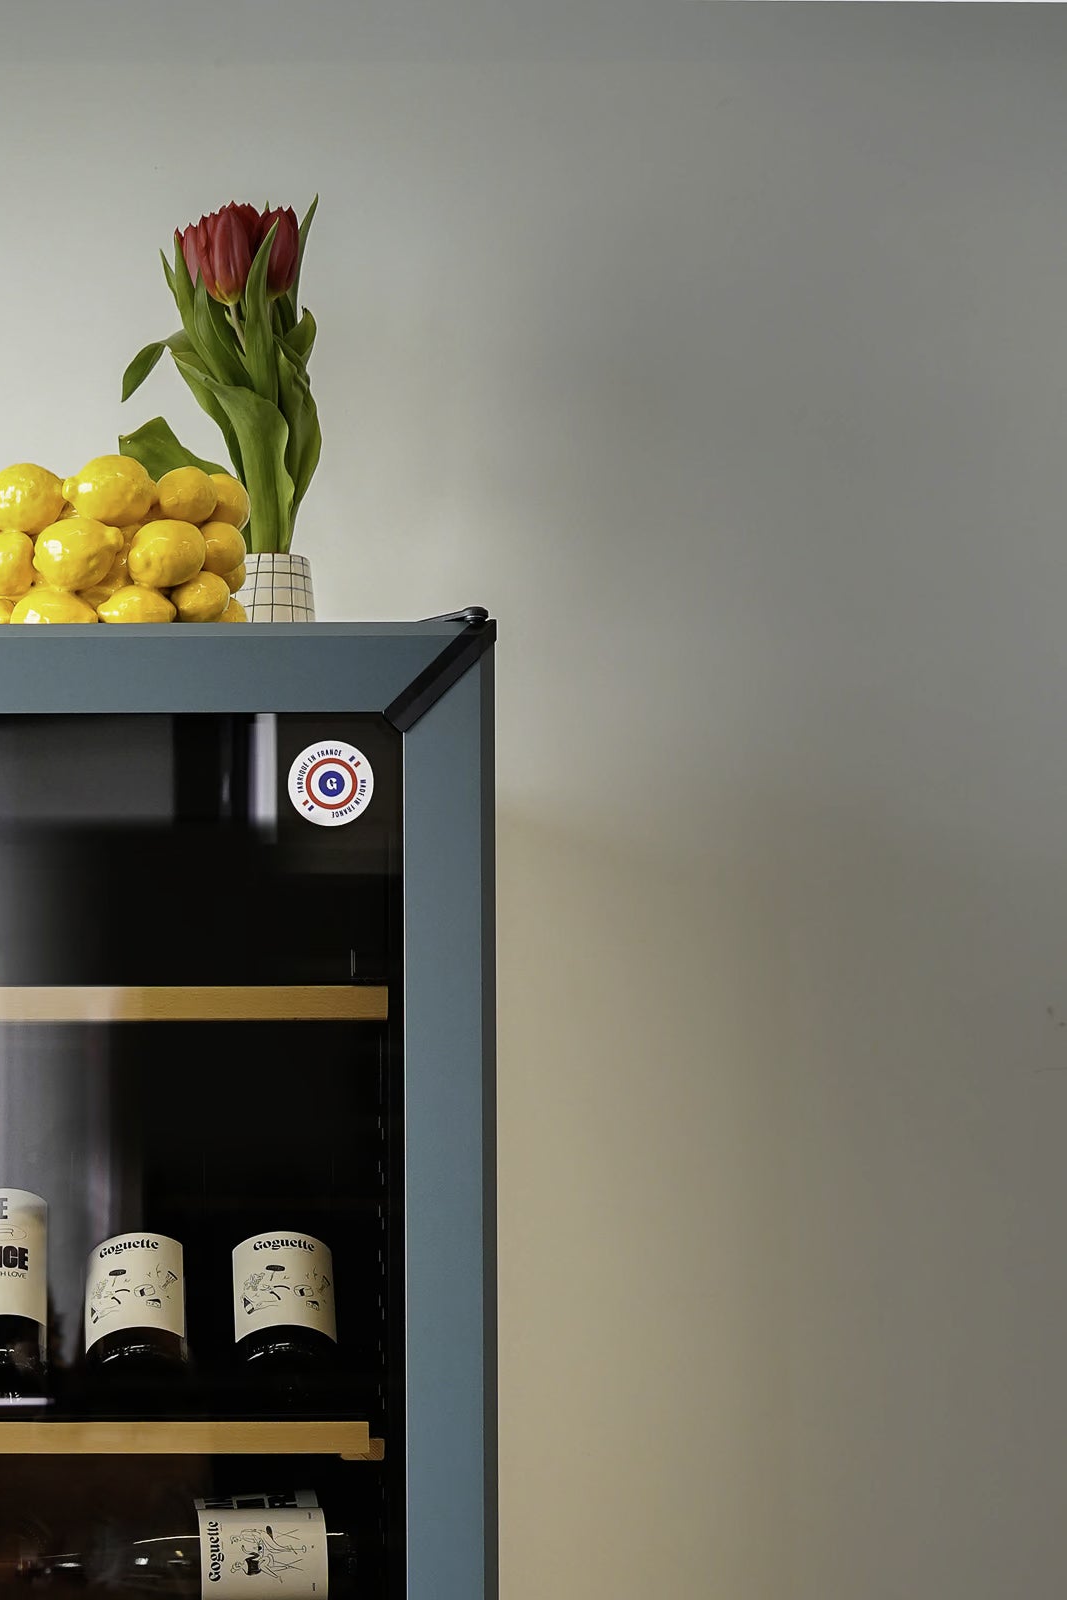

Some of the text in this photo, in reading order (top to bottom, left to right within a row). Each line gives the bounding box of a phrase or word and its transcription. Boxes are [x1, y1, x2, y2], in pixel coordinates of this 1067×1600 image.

[307, 754, 317, 764] EN
[317, 749, 342, 758] FRANCE
[326, 778, 337, 790] G
[332, 779, 367, 818] MADE IN FRANCE
[99, 1238, 159, 1258] Goguette
[253, 1238, 315, 1252] Goguette
[7, 1270, 28, 1279] LOVE
[207, 1521, 225, 1582] Goguette
